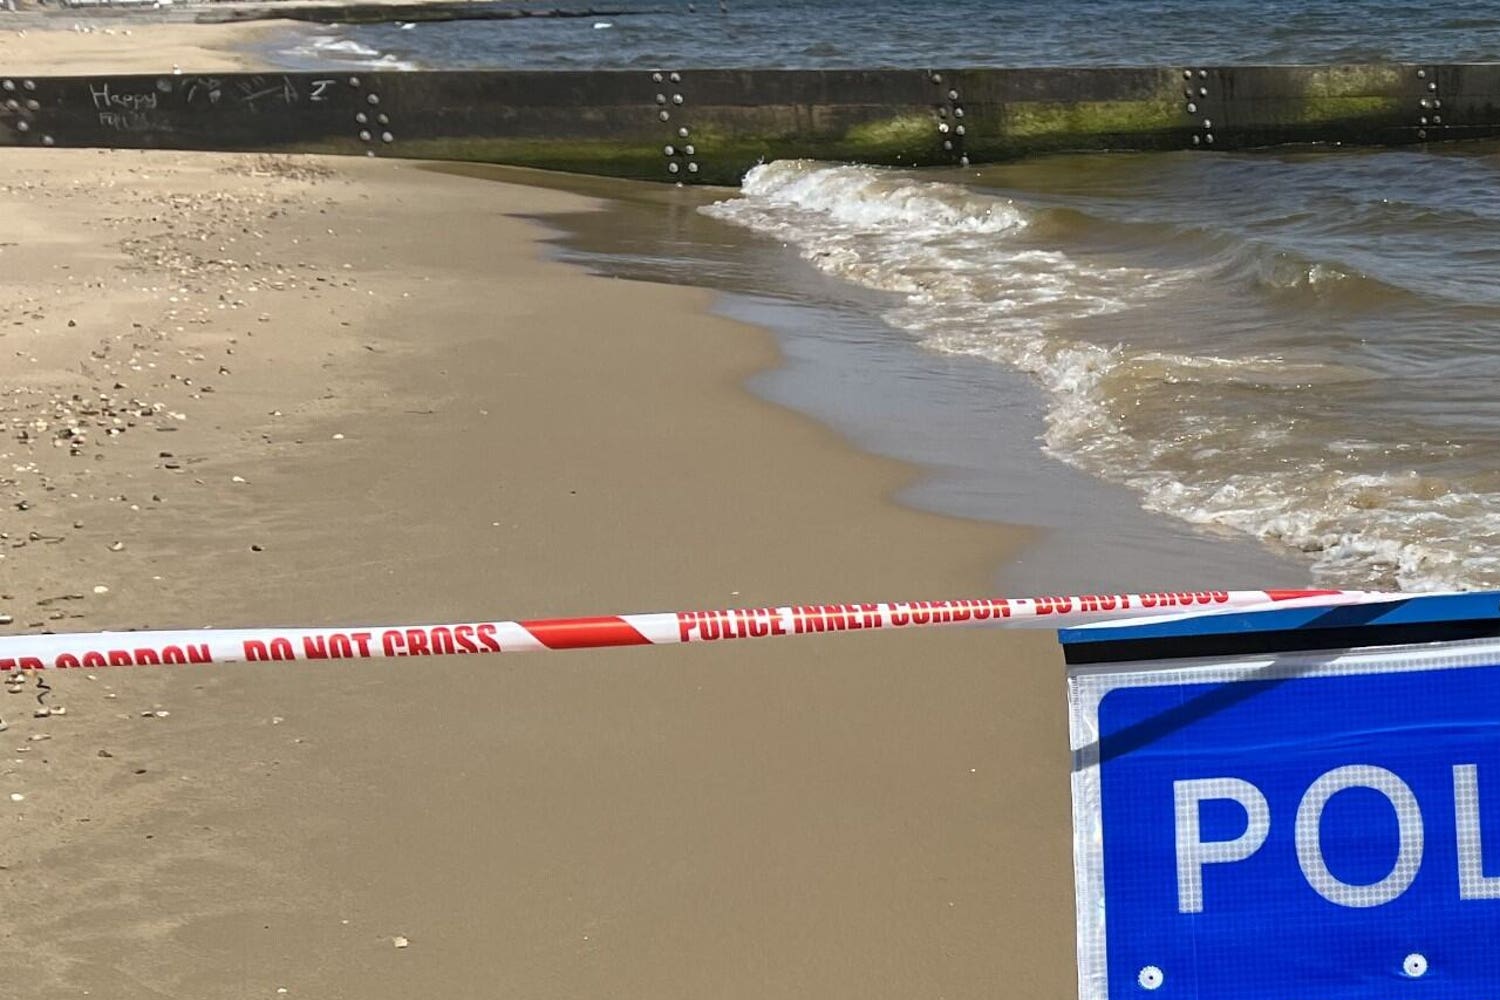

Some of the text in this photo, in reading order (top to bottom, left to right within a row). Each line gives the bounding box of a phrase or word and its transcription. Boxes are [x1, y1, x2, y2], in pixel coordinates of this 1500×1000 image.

[676, 606, 787, 643] POLICE
[791, 603, 882, 635] INNER
[243, 637, 296, 662] DO
[303, 632, 372, 660] NOT
[382, 624, 501, 657] CROSS
